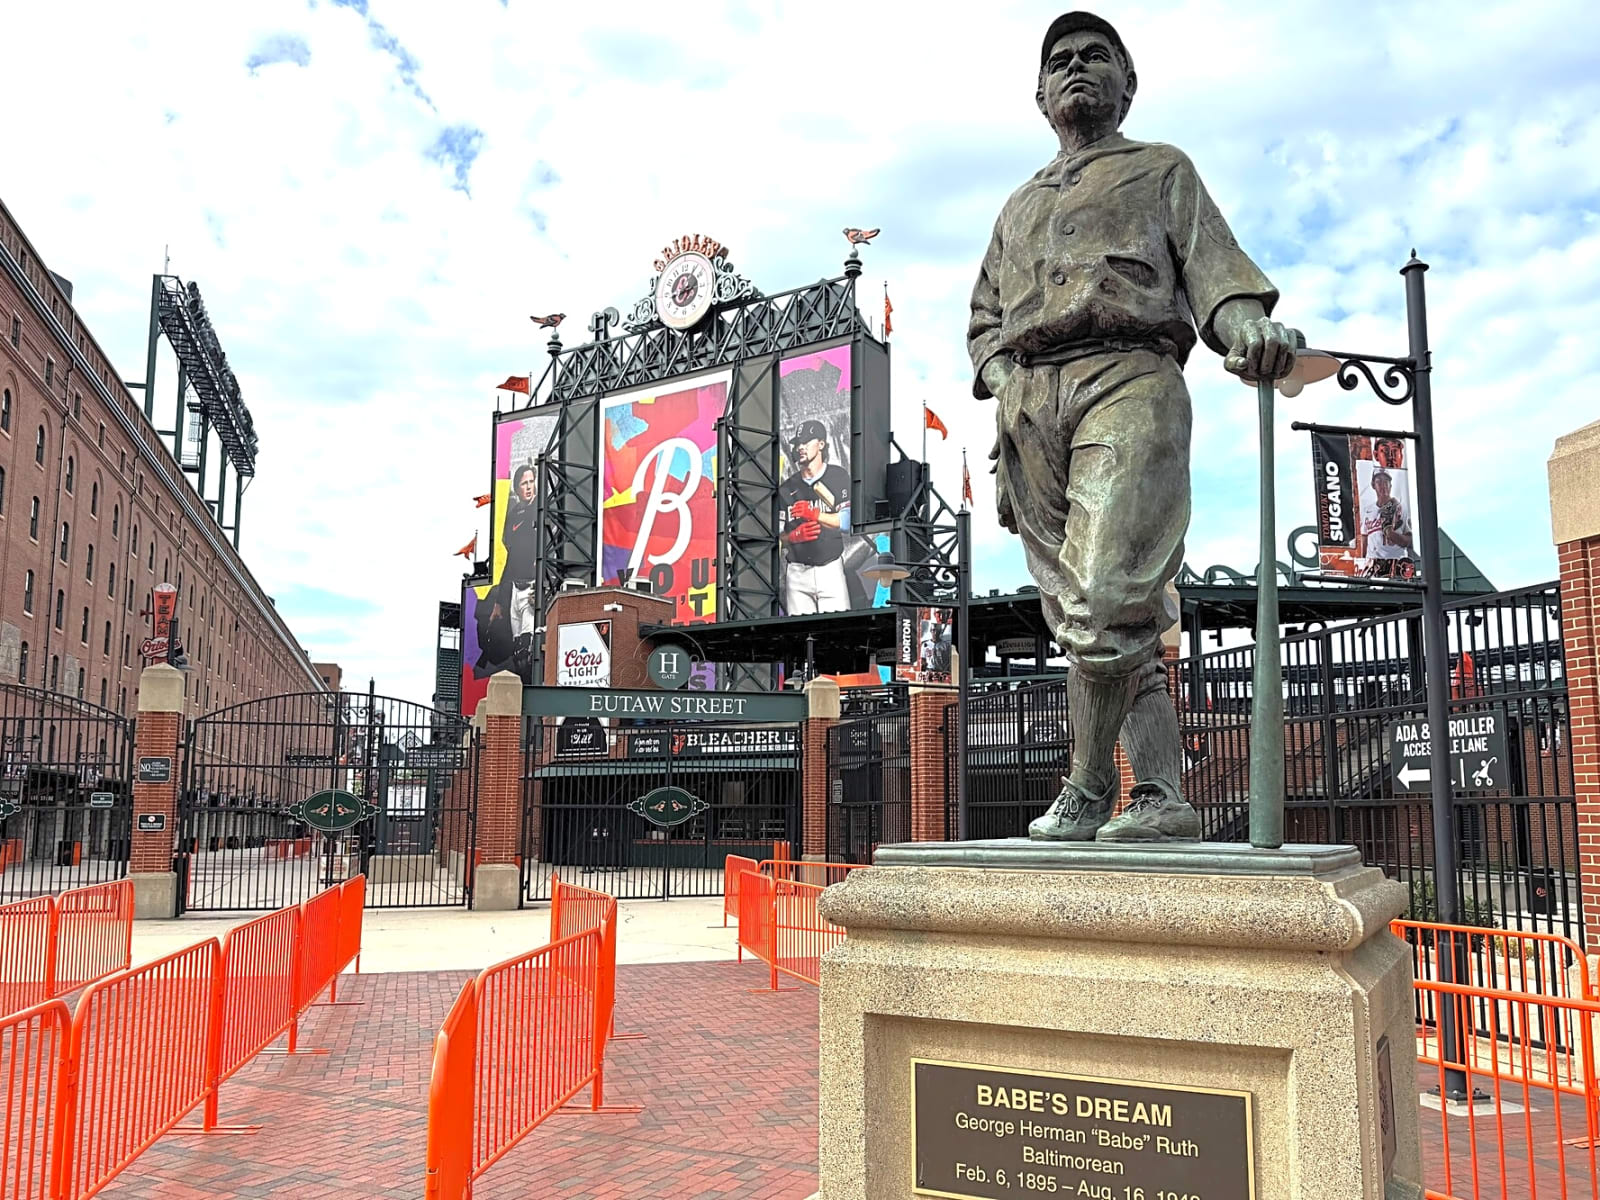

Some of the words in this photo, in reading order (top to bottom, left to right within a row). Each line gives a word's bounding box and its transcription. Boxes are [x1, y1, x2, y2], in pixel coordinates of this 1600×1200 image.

[653, 233, 720, 273] ORIOLES
[631, 438, 703, 583] B
[1320, 493, 1330, 540] TOMOYUKI
[1325, 461, 1344, 542] SUGANO
[157, 595, 172, 635] TEAM
[902, 618, 911, 663] MORTON
[565, 649, 603, 667] Coors
[568, 666, 599, 678] LIGHT
[658, 652, 680, 674] H
[590, 694, 664, 713] EUTAW
[670, 696, 747, 715] STREET
[686, 730, 781, 747] BLEACHER
[1395, 724, 1419, 742] ADA
[1421, 723, 1431, 740] &
[1448, 716, 1495, 738] ROLLER
[1461, 737, 1489, 753] LANE
[140, 763, 152, 771] NO
[976, 1084, 1069, 1116] BABE'S
[1075, 1096, 1173, 1128] DREAM
[954, 1112, 1015, 1138] George
[1019, 1119, 1087, 1145] Herman
[1090, 1128, 1151, 1152] "Babe"
[1156, 1136, 1200, 1158] Ruth
[1022, 1146, 1125, 1176] Baltimorean
[955, 1163, 992, 1184] Feb.
[995, 1169, 1011, 1189] 6,
[1017, 1172, 1058, 1193] 1895
[1077, 1180, 1118, 1200] Aug.
